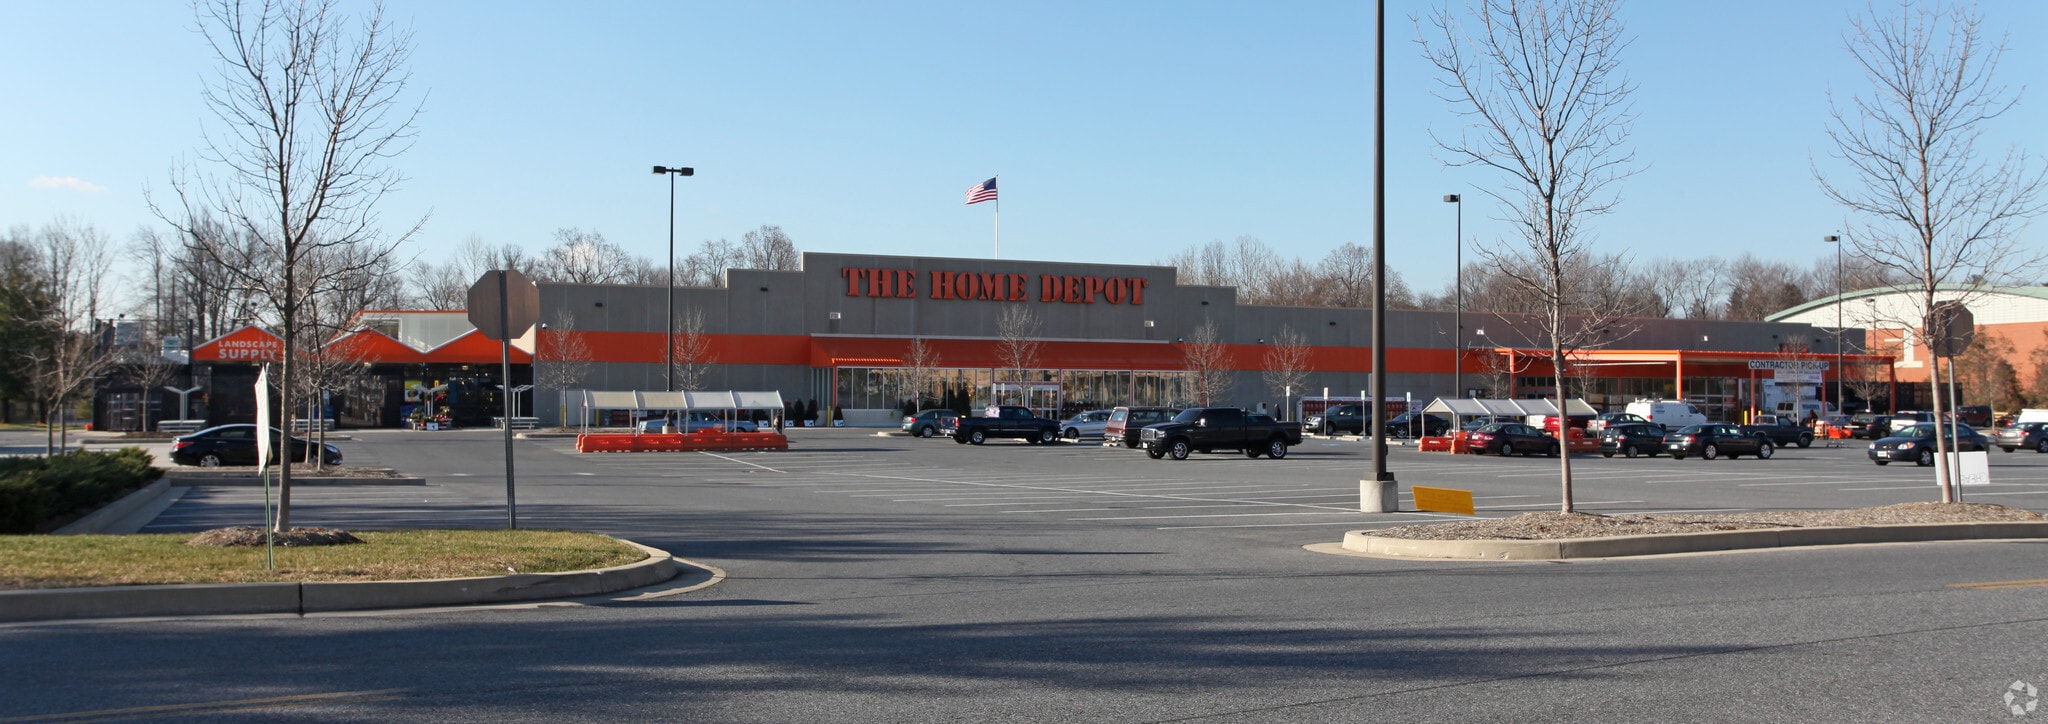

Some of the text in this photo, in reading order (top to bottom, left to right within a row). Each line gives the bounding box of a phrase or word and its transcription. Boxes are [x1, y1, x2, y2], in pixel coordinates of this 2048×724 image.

[841, 267, 1148, 305] THE HOME DEPOT
[219, 349, 276, 359] SUPPLY
[1801, 361, 1829, 369] PICK-UP
